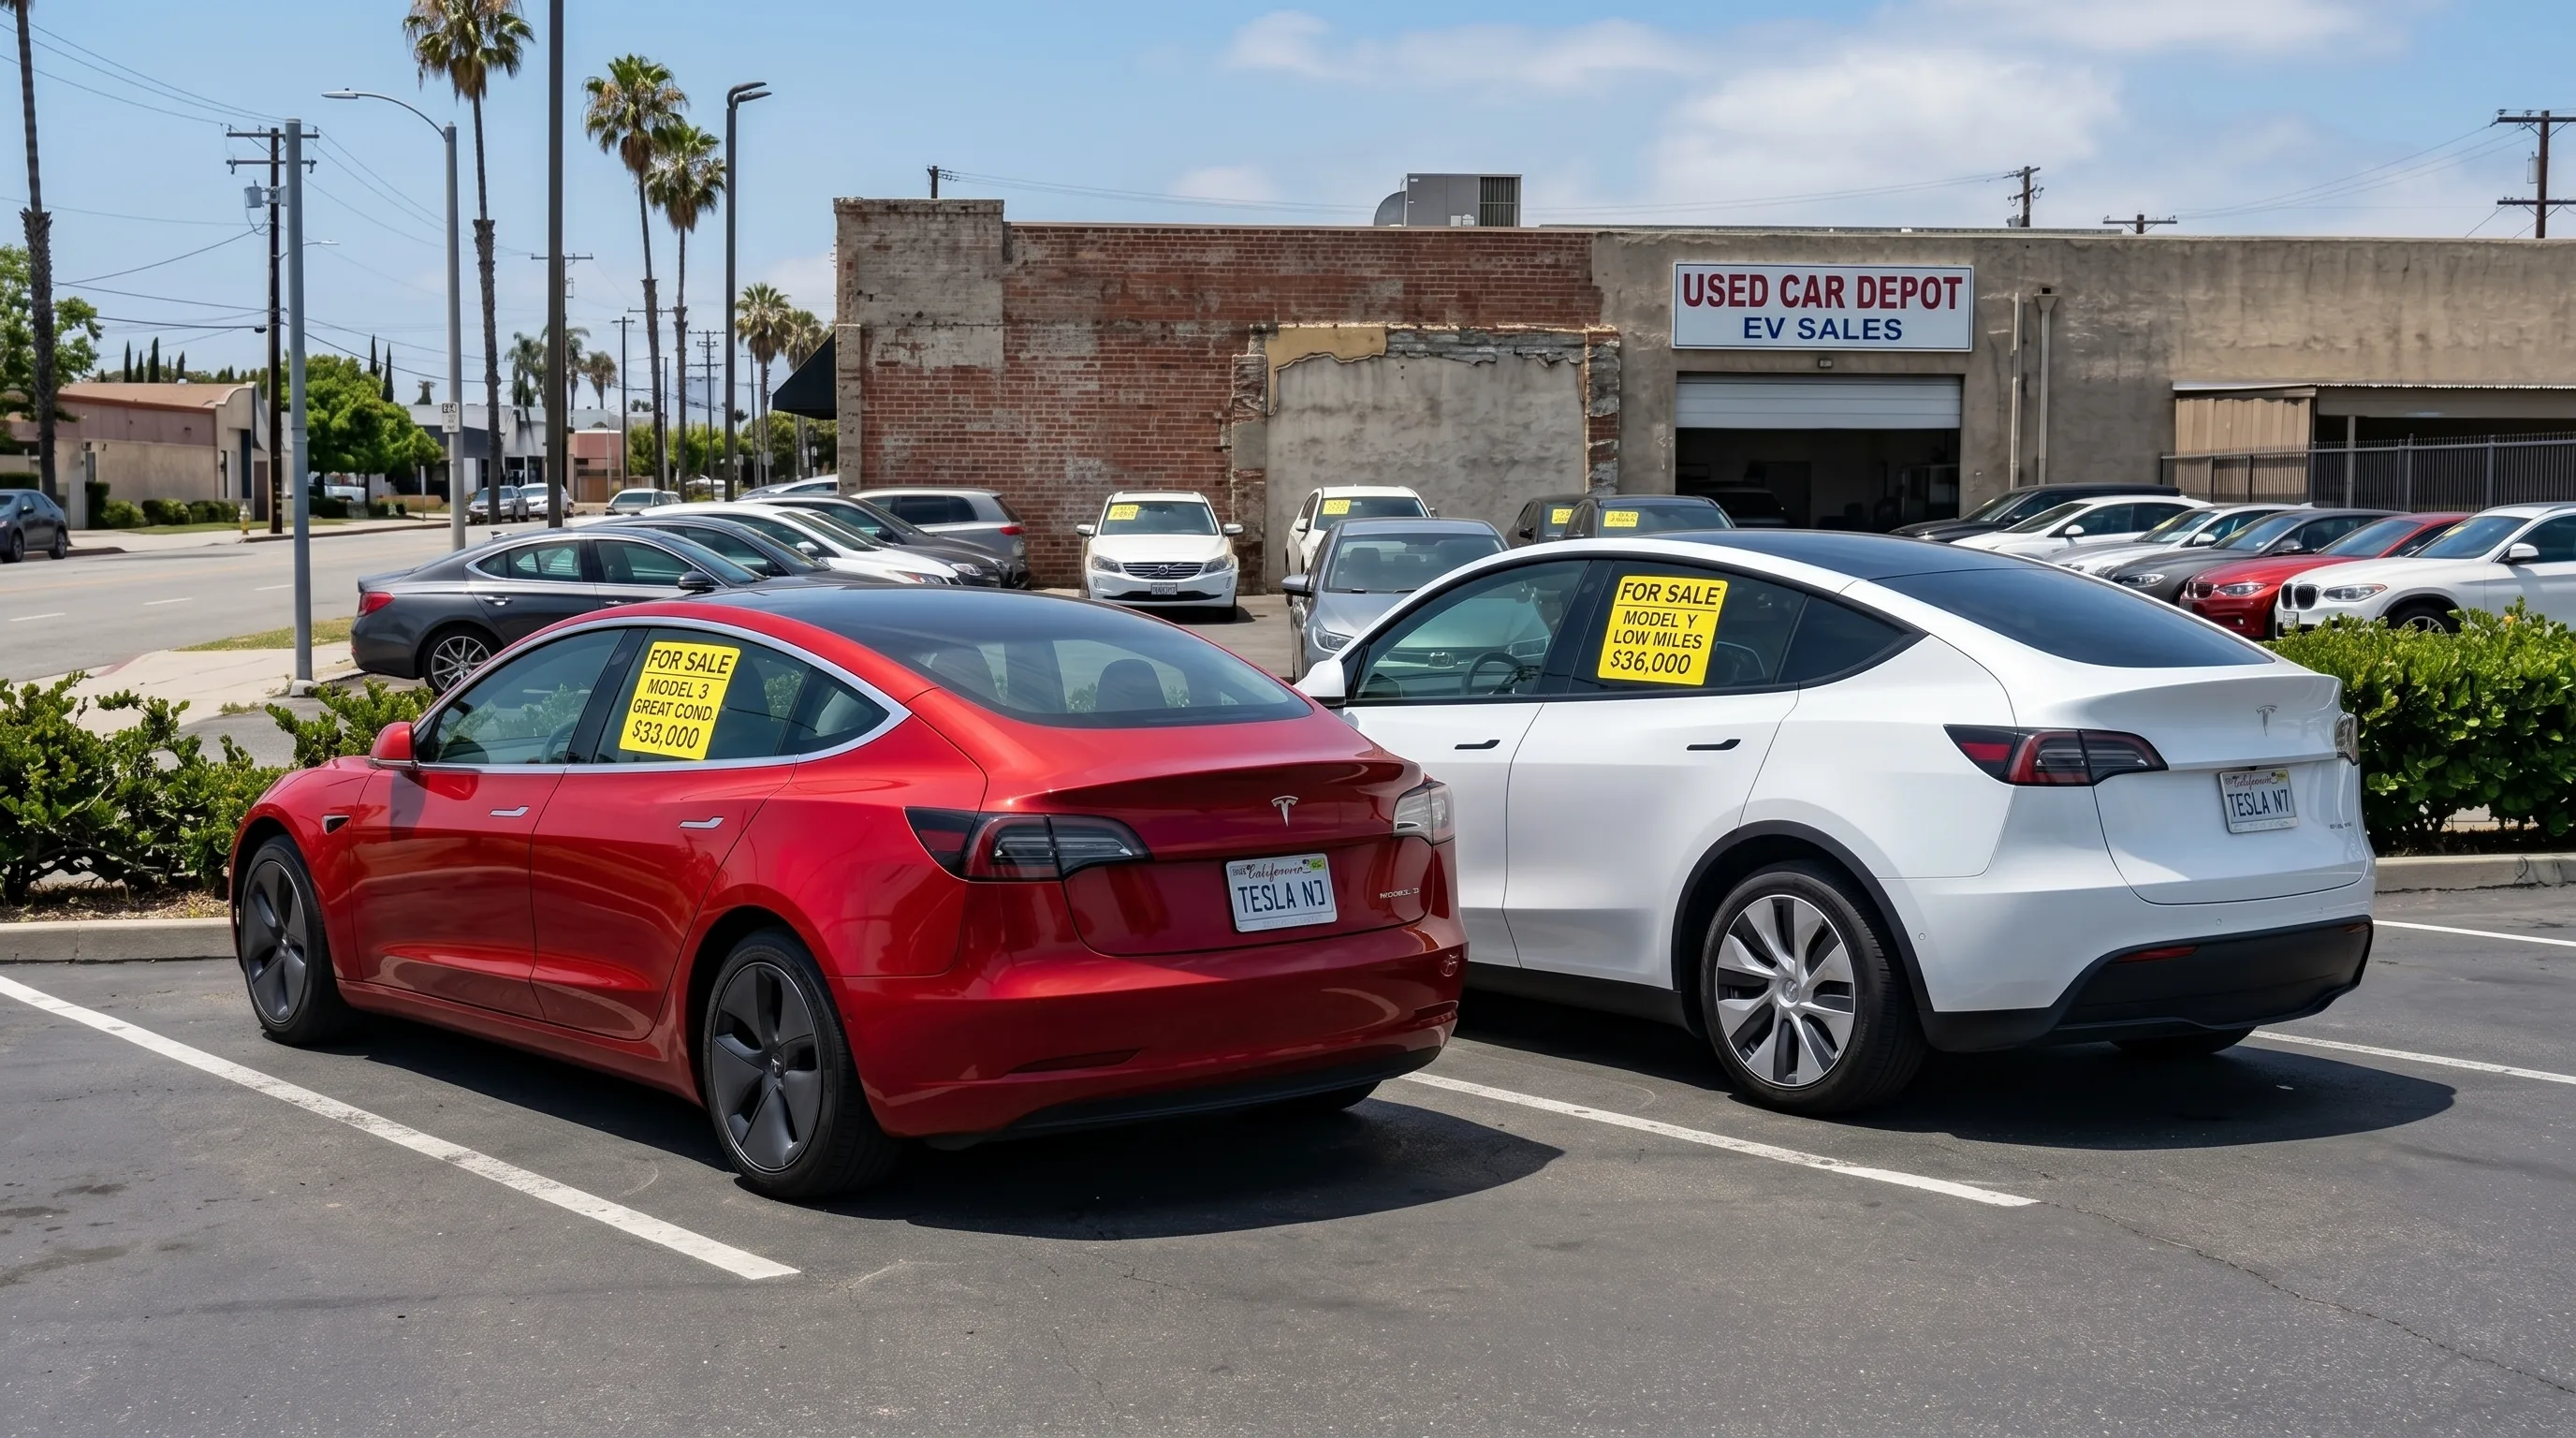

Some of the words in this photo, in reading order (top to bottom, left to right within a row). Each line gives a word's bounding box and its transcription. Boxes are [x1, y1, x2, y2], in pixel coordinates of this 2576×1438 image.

[1683, 272, 1769, 308] USED
[1779, 274, 1846, 309] CAR
[1856, 275, 1964, 310] DEPOT
[1744, 316, 1786, 340] EV
[1797, 317, 1903, 341] SALES
[1619, 582, 1662, 602] FOR
[1665, 584, 1720, 606] SALE
[1622, 610, 1678, 628] MODEL
[1687, 613, 1698, 629] Y
[1613, 629, 1650, 646] LOW
[1652, 631, 1704, 650] MILES
[648, 649, 683, 670] FOR
[684, 652, 733, 674] SALE
[1610, 649, 1691, 675] $36,000
[646, 679, 694, 698] MODEL
[698, 683, 710, 699] 3
[633, 698, 674, 717] GREAT
[674, 703, 714, 722] COND.
[632, 719, 700, 750] $33,000
[2227, 791, 2271, 817] TESLA
[1237, 882, 1296, 913] TESLA
